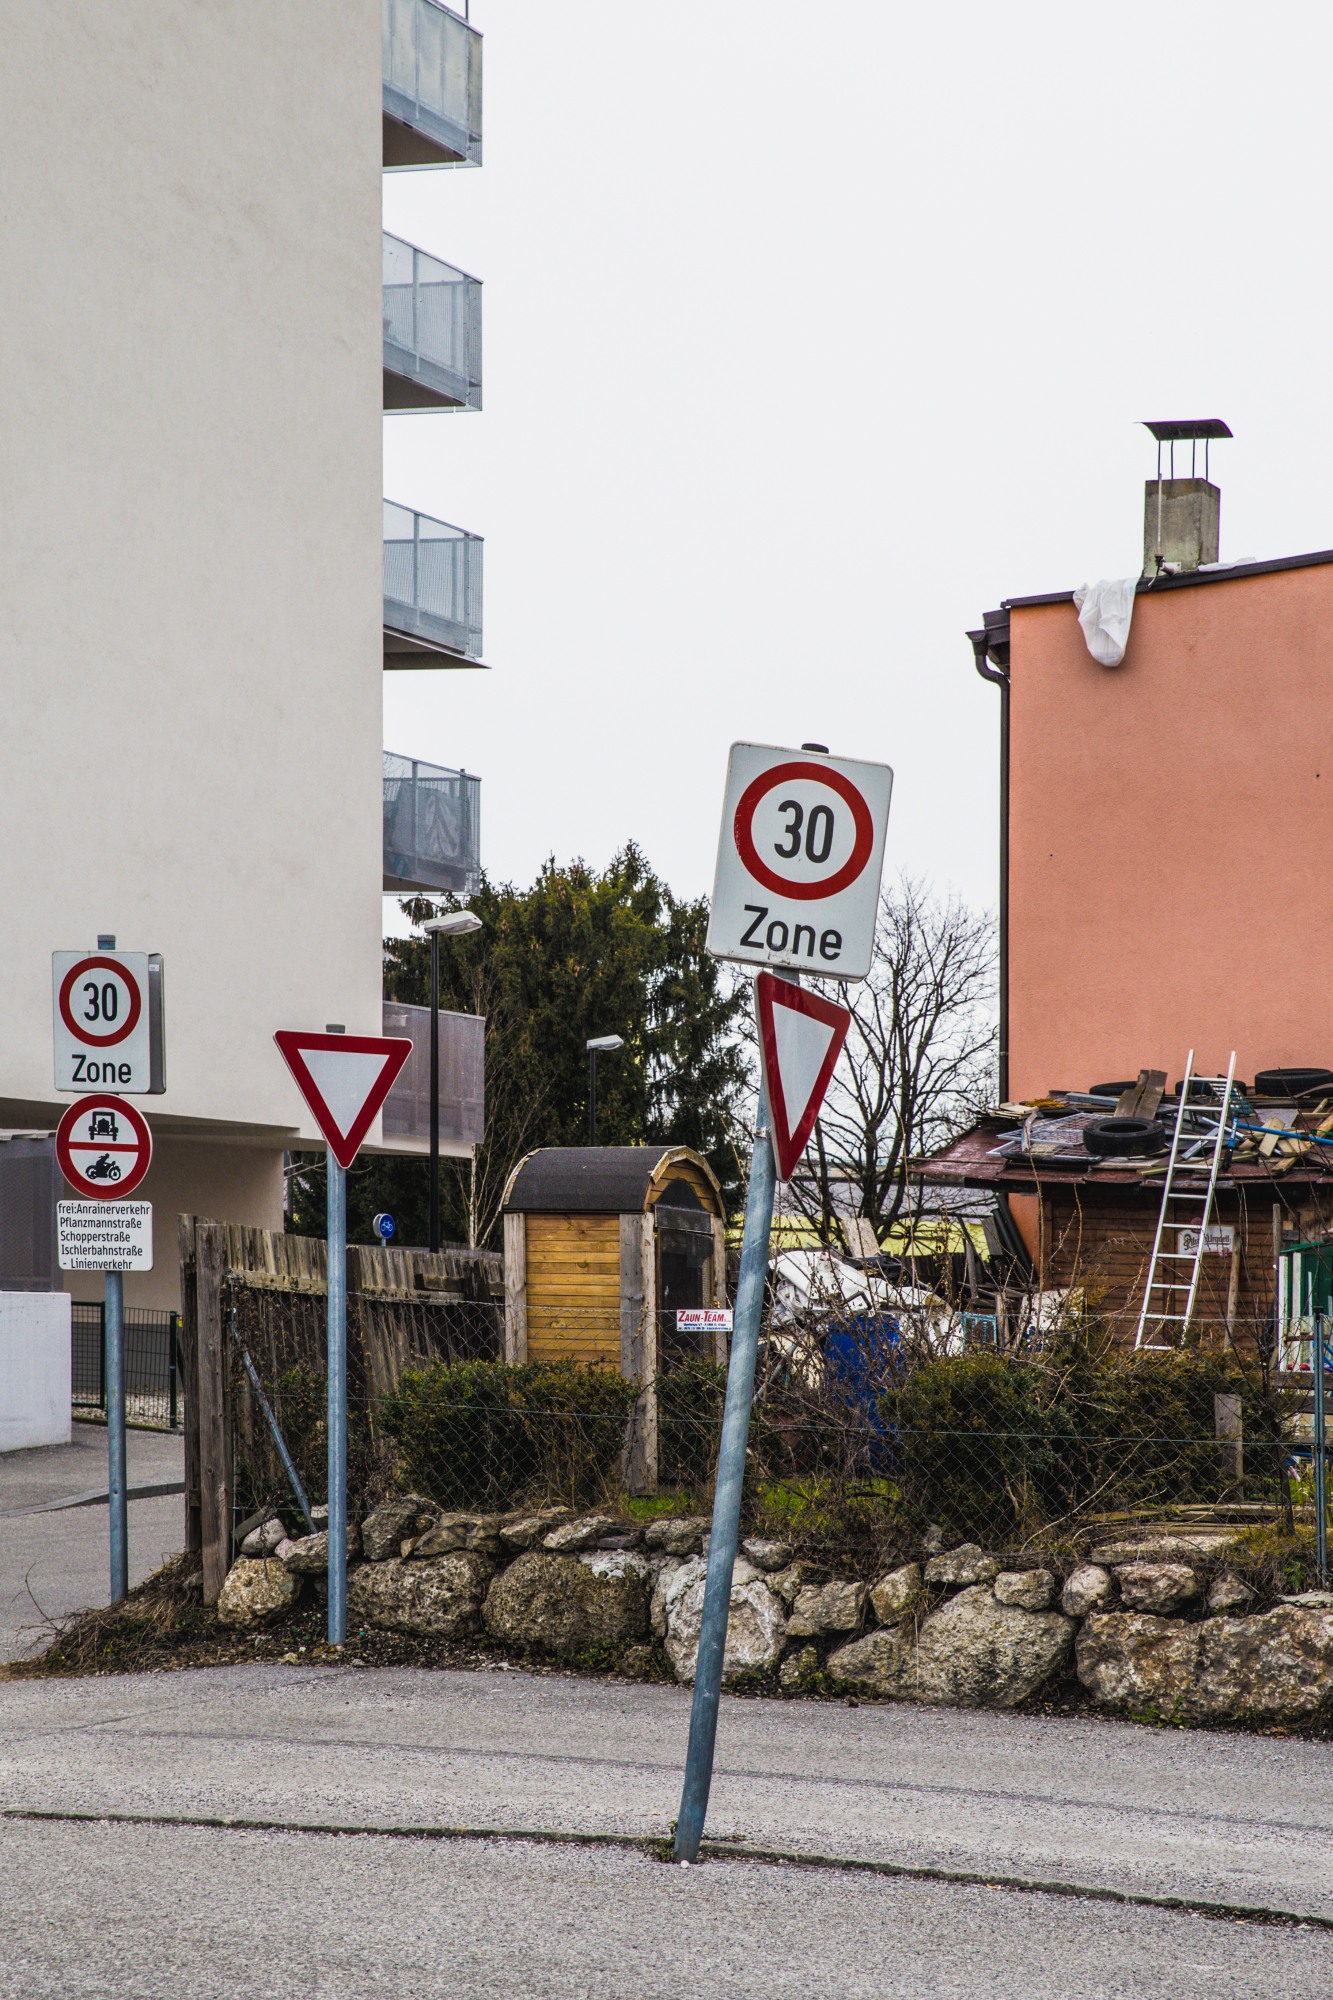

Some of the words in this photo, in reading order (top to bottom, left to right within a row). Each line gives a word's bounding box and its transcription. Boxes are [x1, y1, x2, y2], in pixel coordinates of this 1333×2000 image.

[774, 799, 835, 864] 30
[739, 904, 843, 961] Zone
[83, 982, 118, 1022] 30
[71, 1054, 132, 1084] Zone
[60, 1217, 142, 1229] Pflanzmannstraße
[60, 1230, 131, 1244] Schopperstraße
[61, 1244, 143, 1256] Ischlerbahnstraße
[70, 1257, 133, 1270] Linienverkehr
